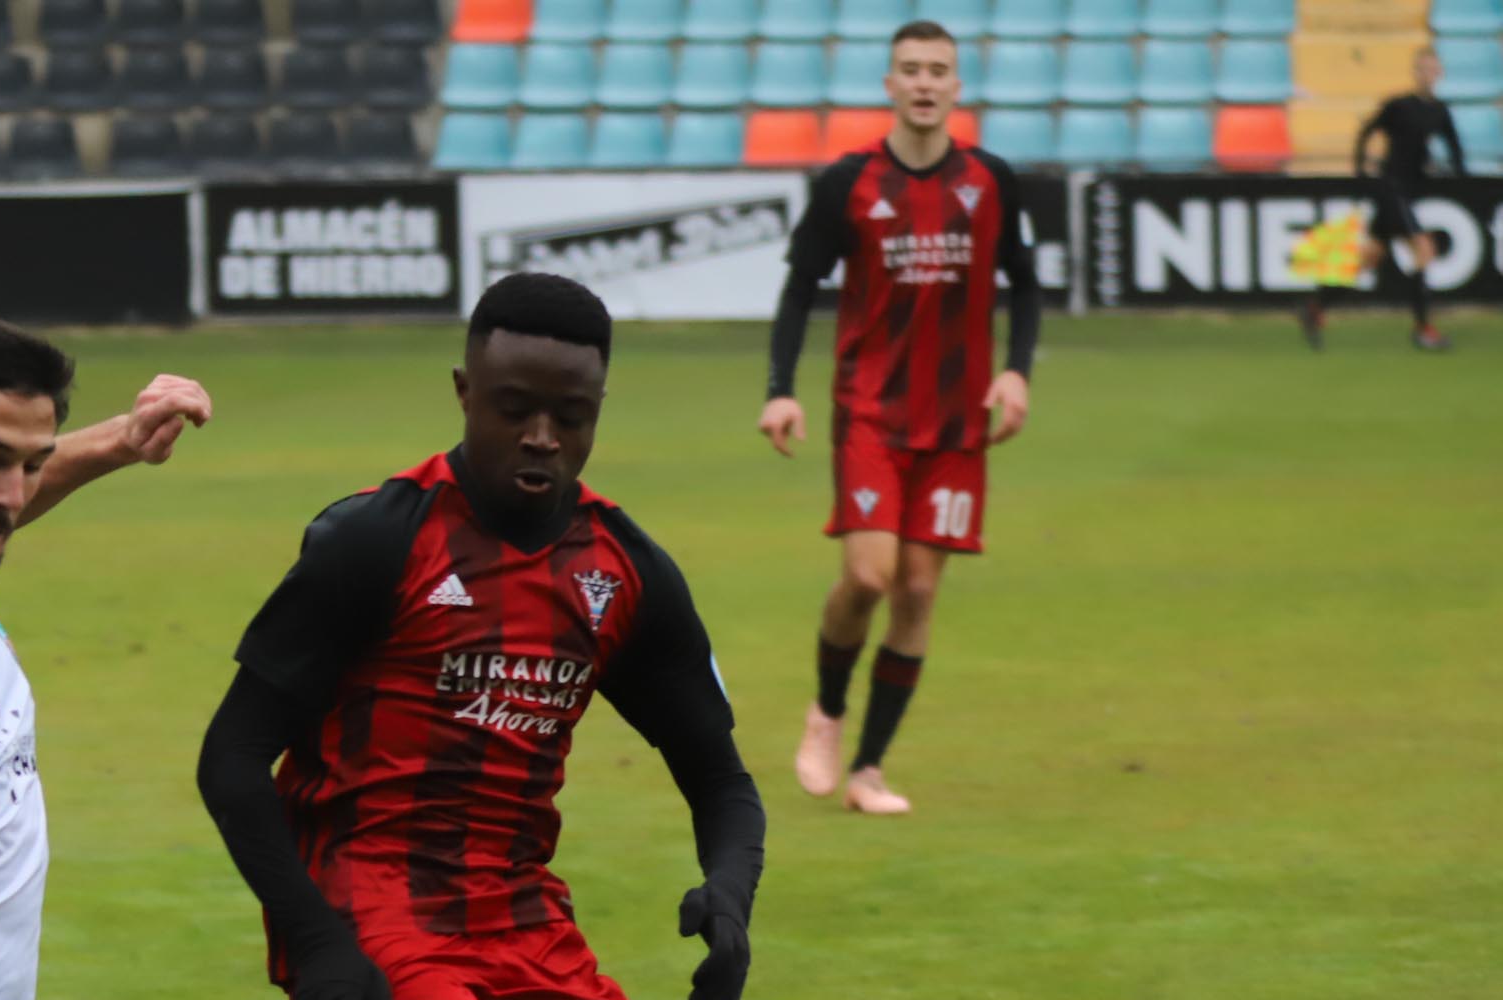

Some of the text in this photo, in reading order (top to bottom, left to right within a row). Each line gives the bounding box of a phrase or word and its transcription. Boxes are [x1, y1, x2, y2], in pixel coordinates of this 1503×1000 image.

[228, 199, 438, 250] ALMACÉN
[219, 254, 450, 298] DE HIERRO
[930, 487, 974, 539] 10
[441, 652, 594, 685] MIRANDA
[454, 692, 559, 735] Ahora
